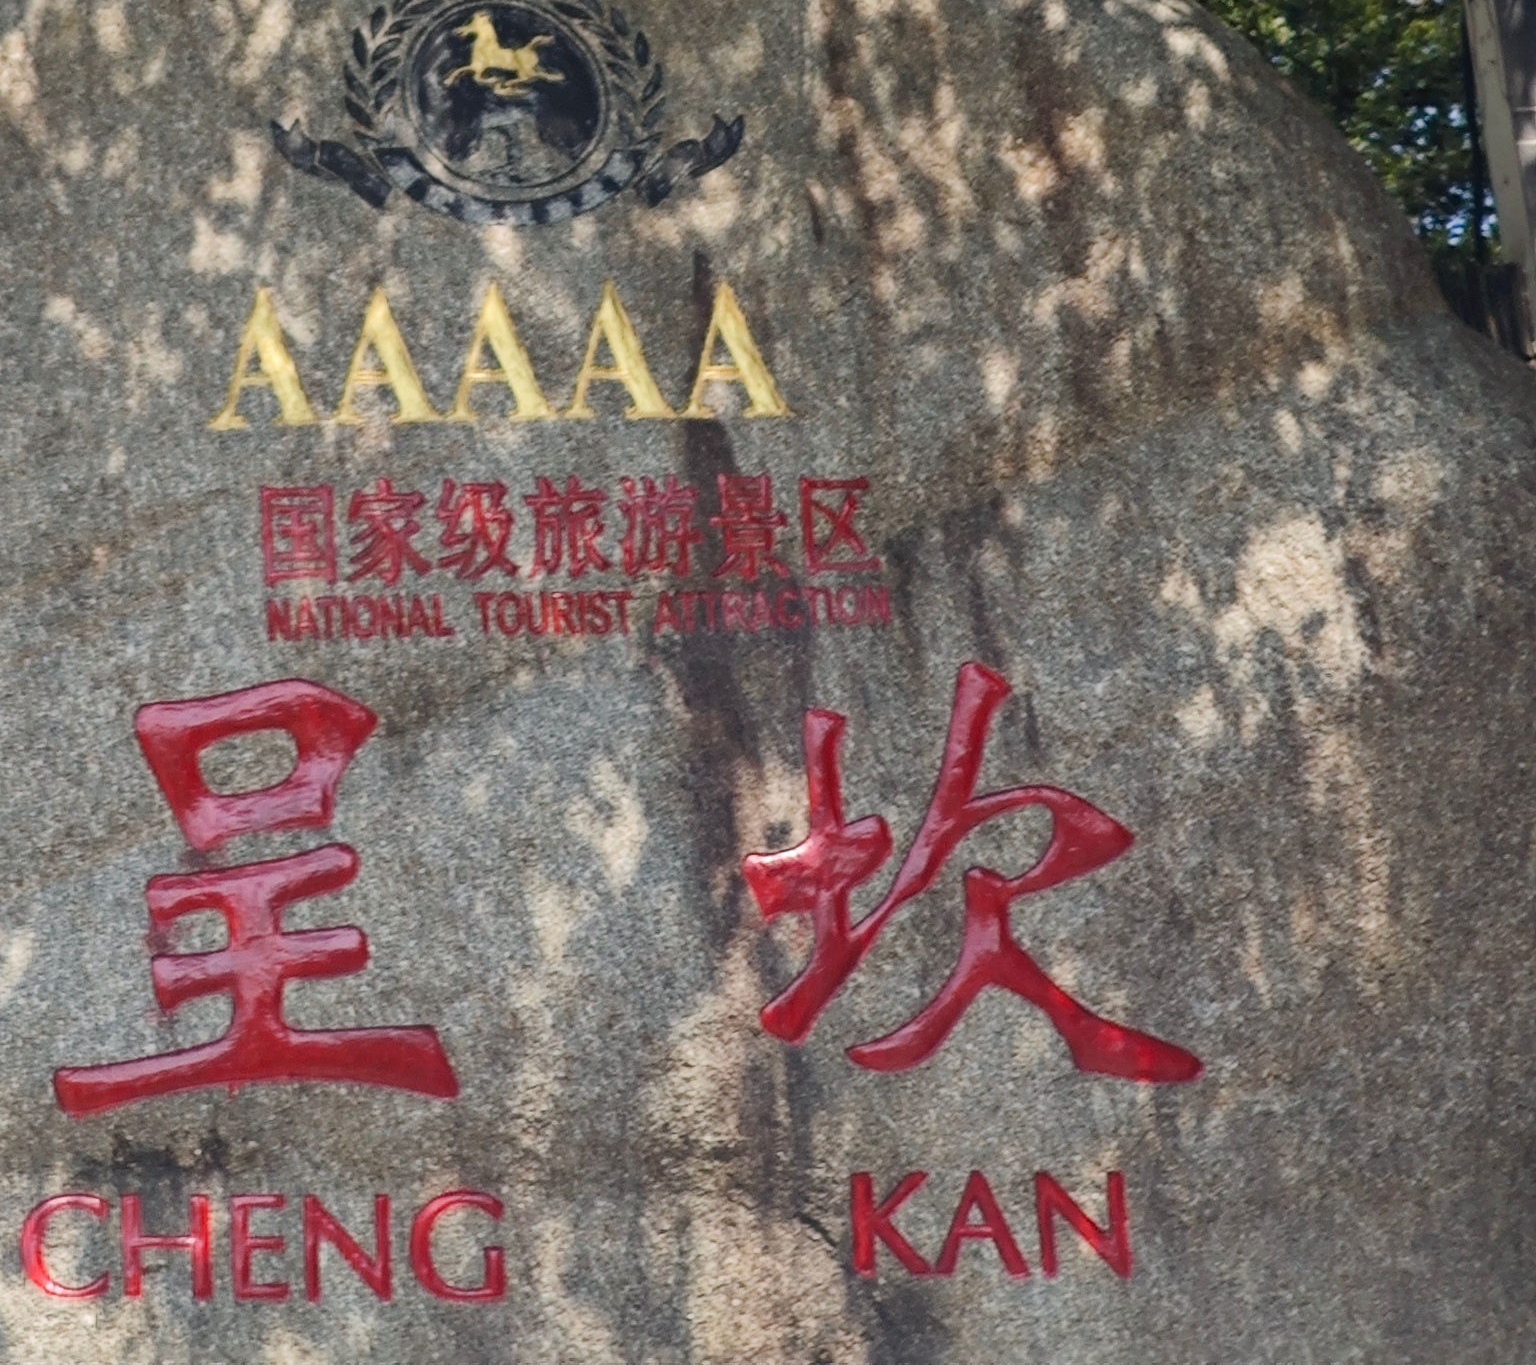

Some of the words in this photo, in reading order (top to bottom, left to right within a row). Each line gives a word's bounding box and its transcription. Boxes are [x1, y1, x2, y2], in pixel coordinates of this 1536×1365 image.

[211, 281, 790, 429] AAAAA
[260, 472, 881, 587] 国家级旅游景区
[266, 593, 455, 642] NATIONAL
[474, 590, 633, 637] TOURIST
[653, 585, 892, 633] ATTRACTION
[20, 1189, 506, 1303] CHENG
[850, 1171, 1133, 1279] KAN
